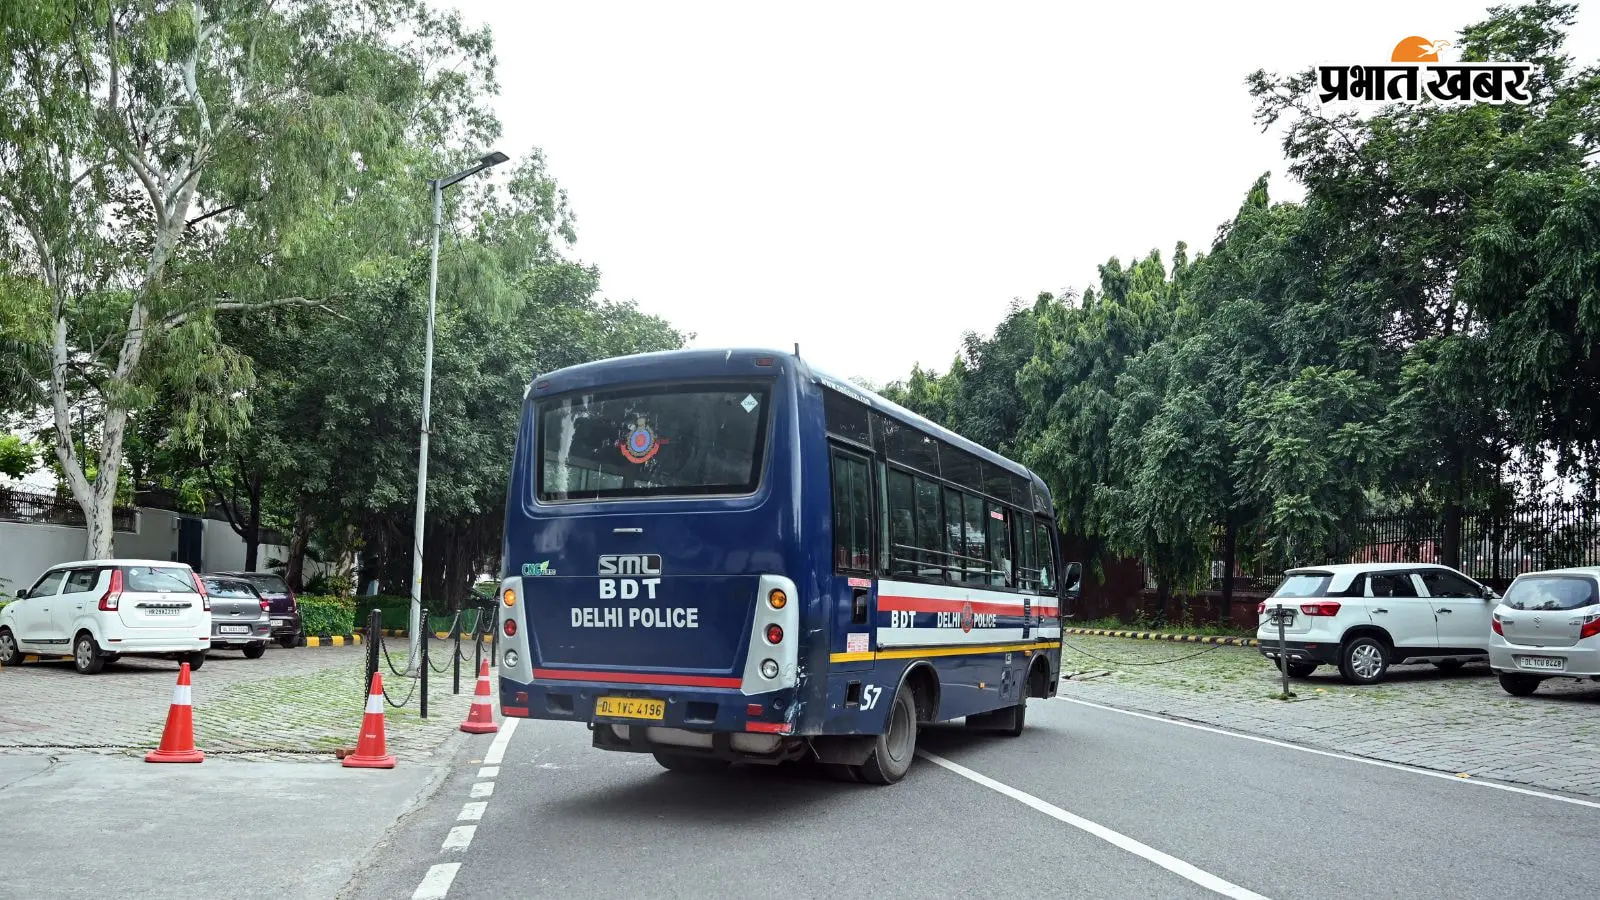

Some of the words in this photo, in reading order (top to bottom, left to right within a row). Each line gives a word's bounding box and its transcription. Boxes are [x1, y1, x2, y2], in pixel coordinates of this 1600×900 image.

[600, 556, 660, 574] SML
[600, 578, 661, 599] BDT
[571, 607, 623, 628] DELHI
[629, 607, 699, 628] POLICE
[891, 610, 916, 628] BDT
[937, 611, 961, 628] DELHI
[973, 613, 997, 628] POLICE
[601, 701, 613, 713] DL
[617, 702, 634, 714] 1VC
[636, 704, 662, 717] 4196
